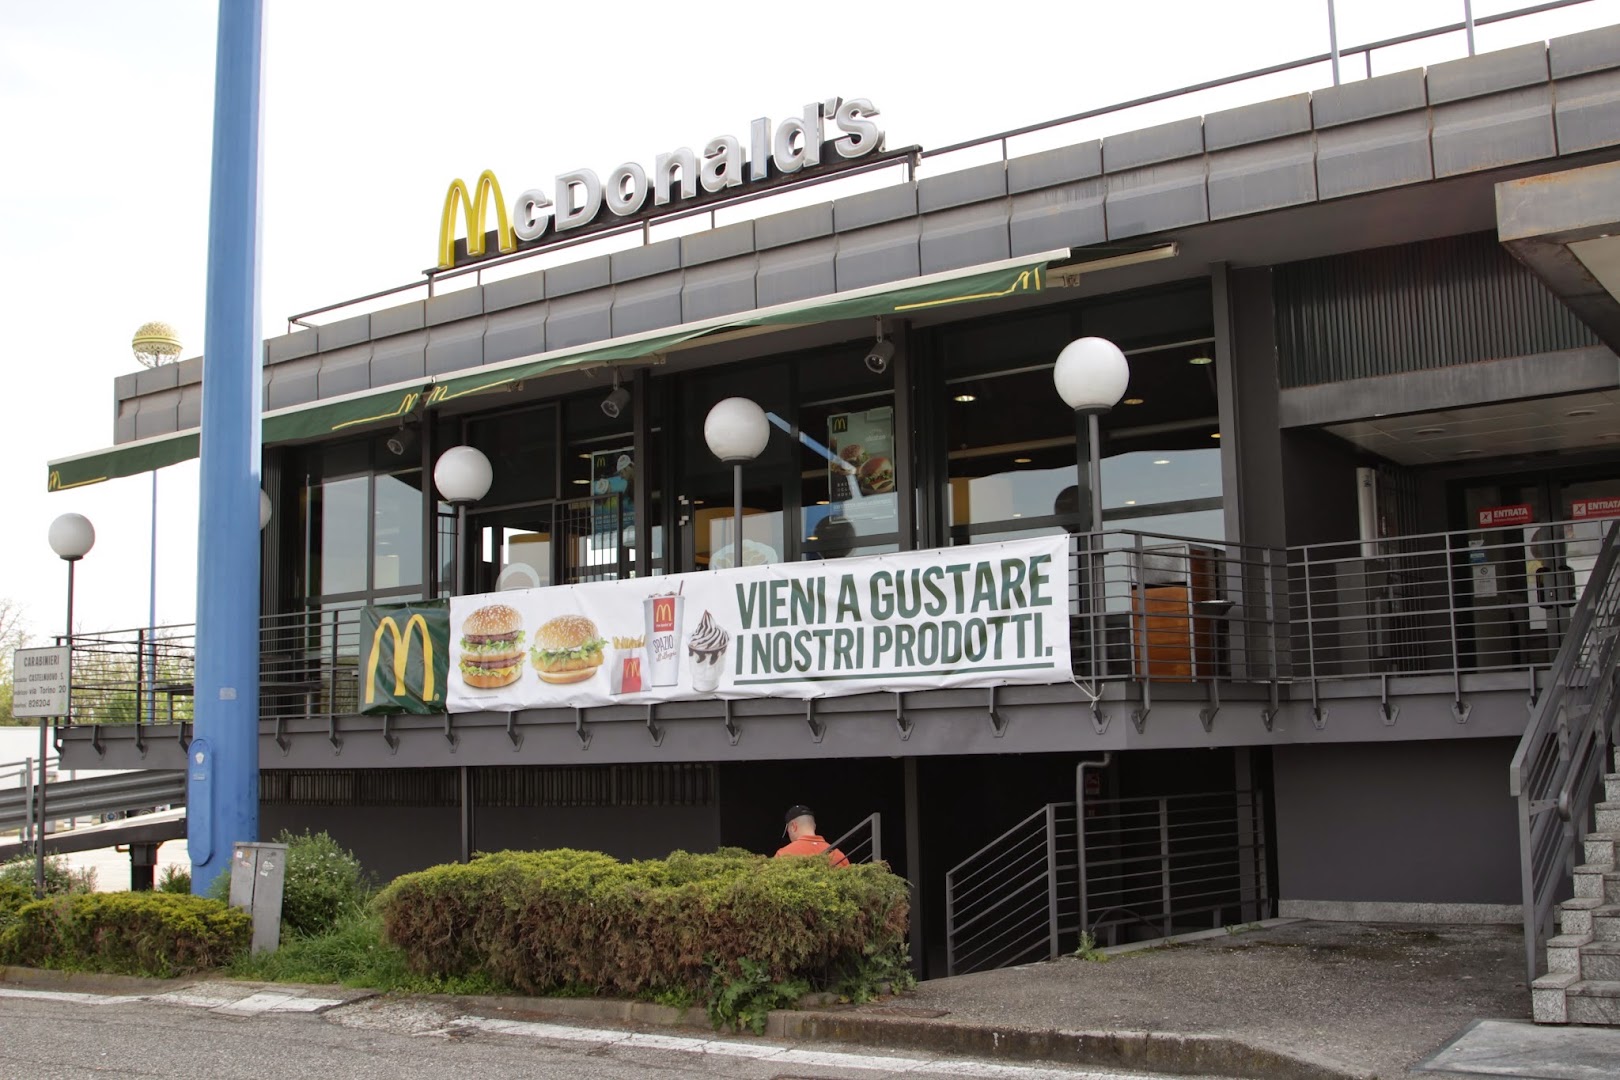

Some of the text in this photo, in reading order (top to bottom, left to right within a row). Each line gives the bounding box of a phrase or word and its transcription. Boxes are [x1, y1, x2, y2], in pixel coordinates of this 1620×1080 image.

[438, 96, 886, 269] McDonald's
[1493, 507, 1528, 518] ENTRATA
[735, 553, 1053, 630] VIENI A GUSTARE
[24, 655, 59, 667] CARABINIERI
[735, 612, 1054, 675] I NOSTRI PRODOTTI.
